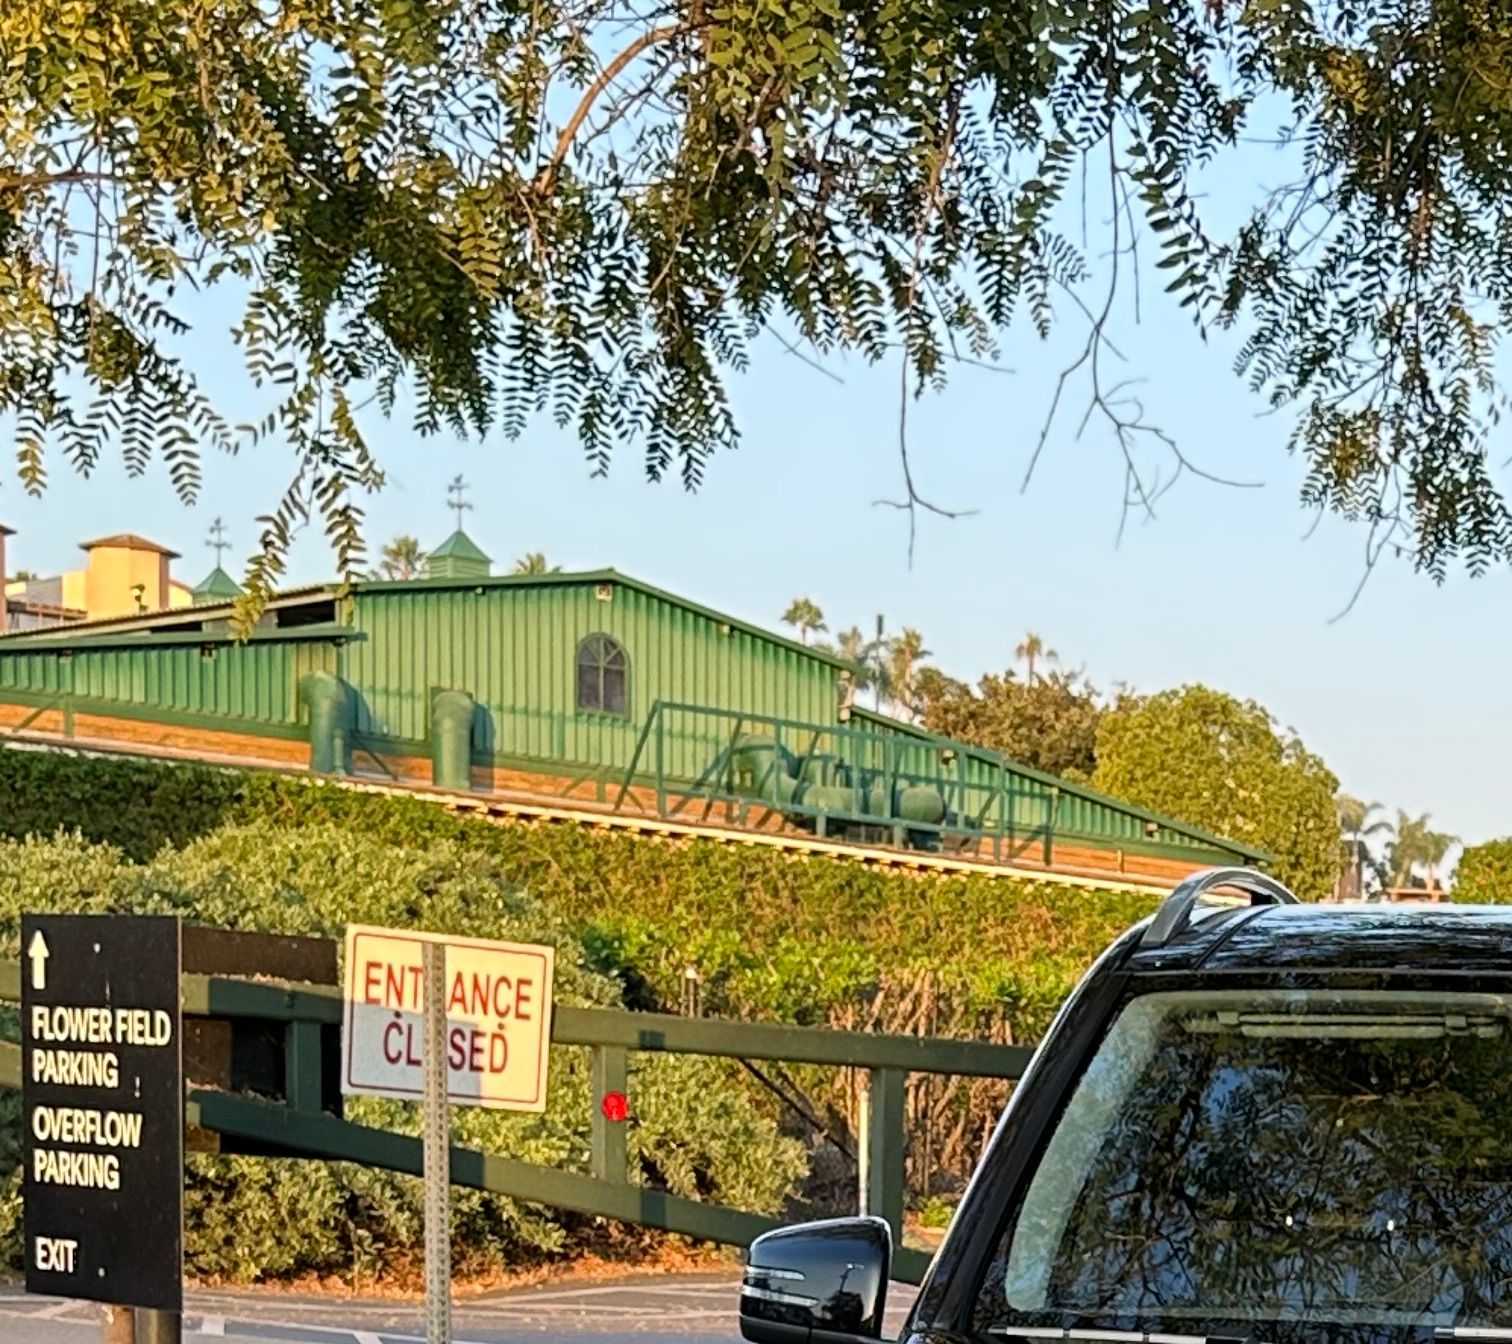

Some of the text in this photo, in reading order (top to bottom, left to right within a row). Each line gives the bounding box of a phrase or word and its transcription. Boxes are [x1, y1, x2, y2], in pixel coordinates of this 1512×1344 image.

[365, 960, 533, 1021] ENTANCE
[32, 1005, 172, 1046] FLOWER FIELD
[32, 1048, 119, 1088] PARKING
[383, 1021, 508, 1074] CLSED
[32, 1105, 143, 1147] OVERFLOW
[33, 1148, 120, 1190] PARKING
[35, 1236, 78, 1273] EXIT
